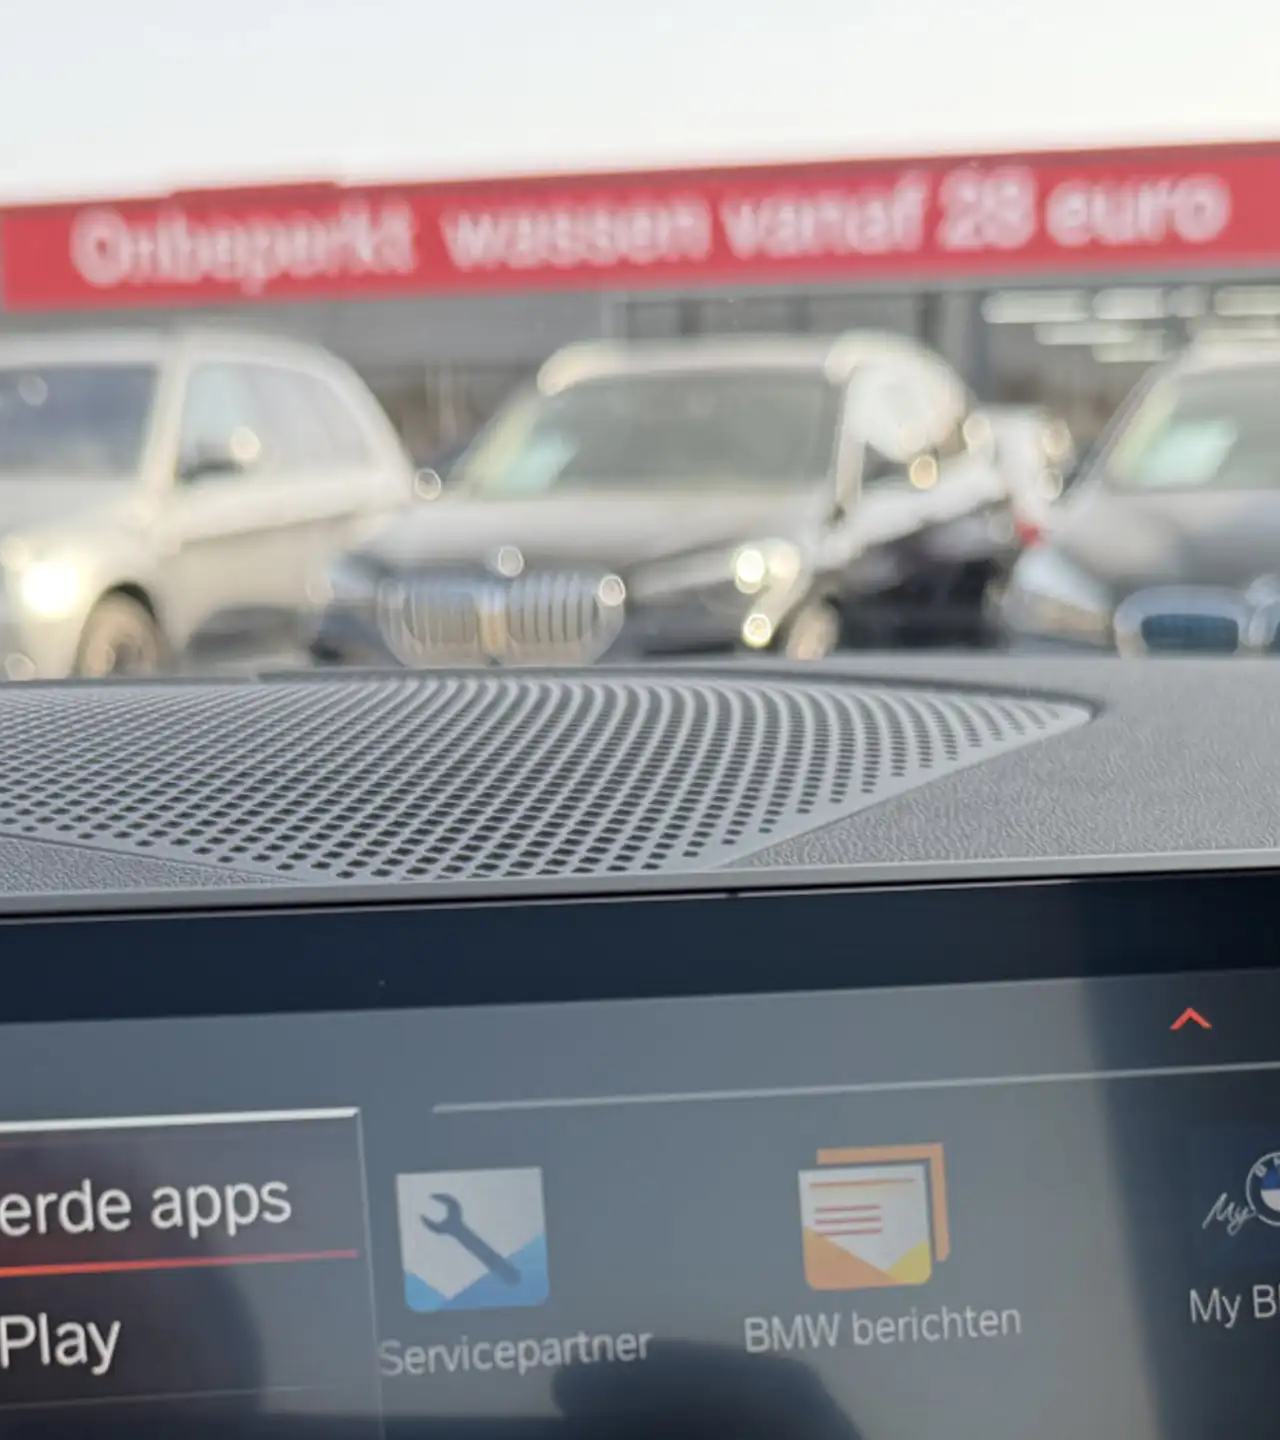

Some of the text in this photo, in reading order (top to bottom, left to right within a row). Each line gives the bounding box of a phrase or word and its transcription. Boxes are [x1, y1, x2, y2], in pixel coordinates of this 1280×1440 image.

[440, 198, 710, 270] wassen
[722, 170, 930, 260] vanaf
[1044, 174, 1230, 248] euro
[149, 1178, 293, 1240] apps
[743, 1303, 1021, 1354] BMW berichten
[1189, 1286, 1242, 1329] My
[379, 1329, 652, 1377] Servicepartner
